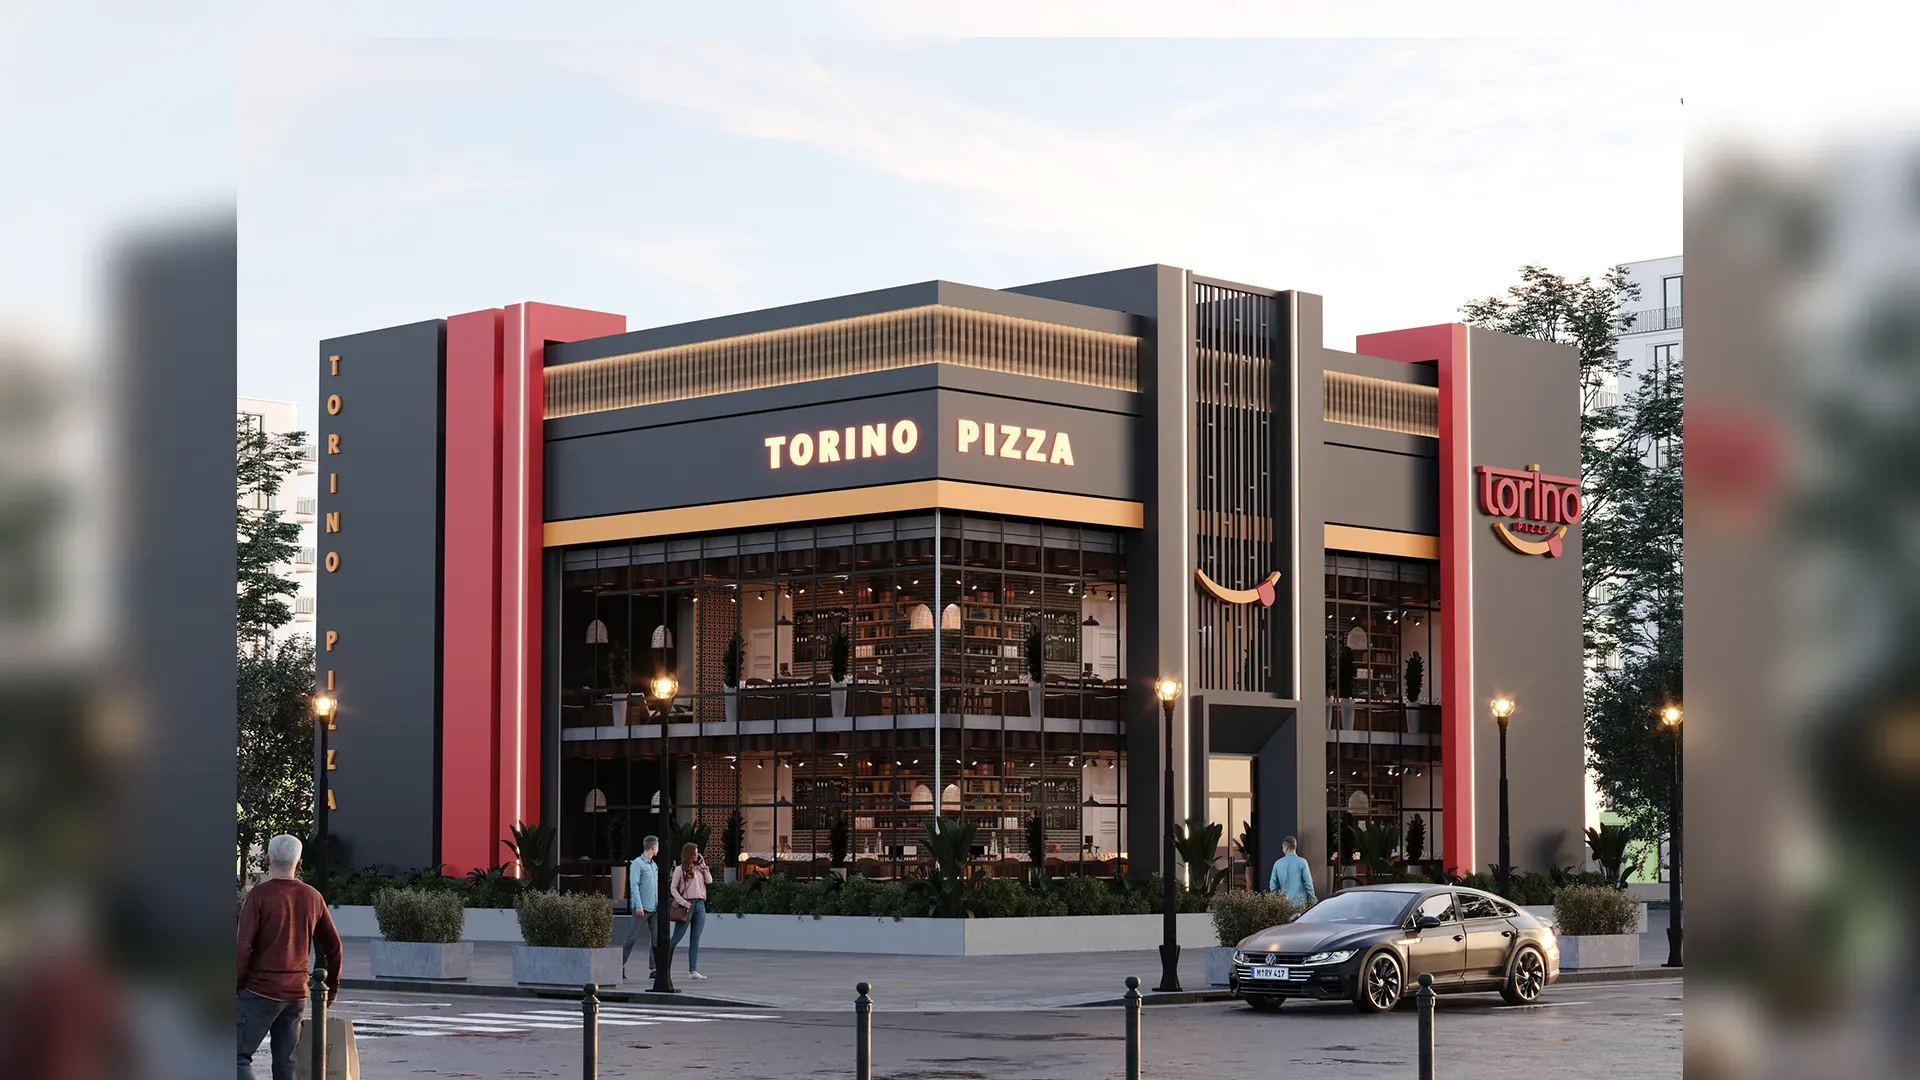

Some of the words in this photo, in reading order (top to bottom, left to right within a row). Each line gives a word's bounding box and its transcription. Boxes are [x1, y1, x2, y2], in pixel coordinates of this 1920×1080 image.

[325, 355, 342, 573] TORINO
[764, 419, 919, 469] TORINO
[957, 419, 1075, 466] PIZZA
[1516, 522, 1550, 535] PIZZA
